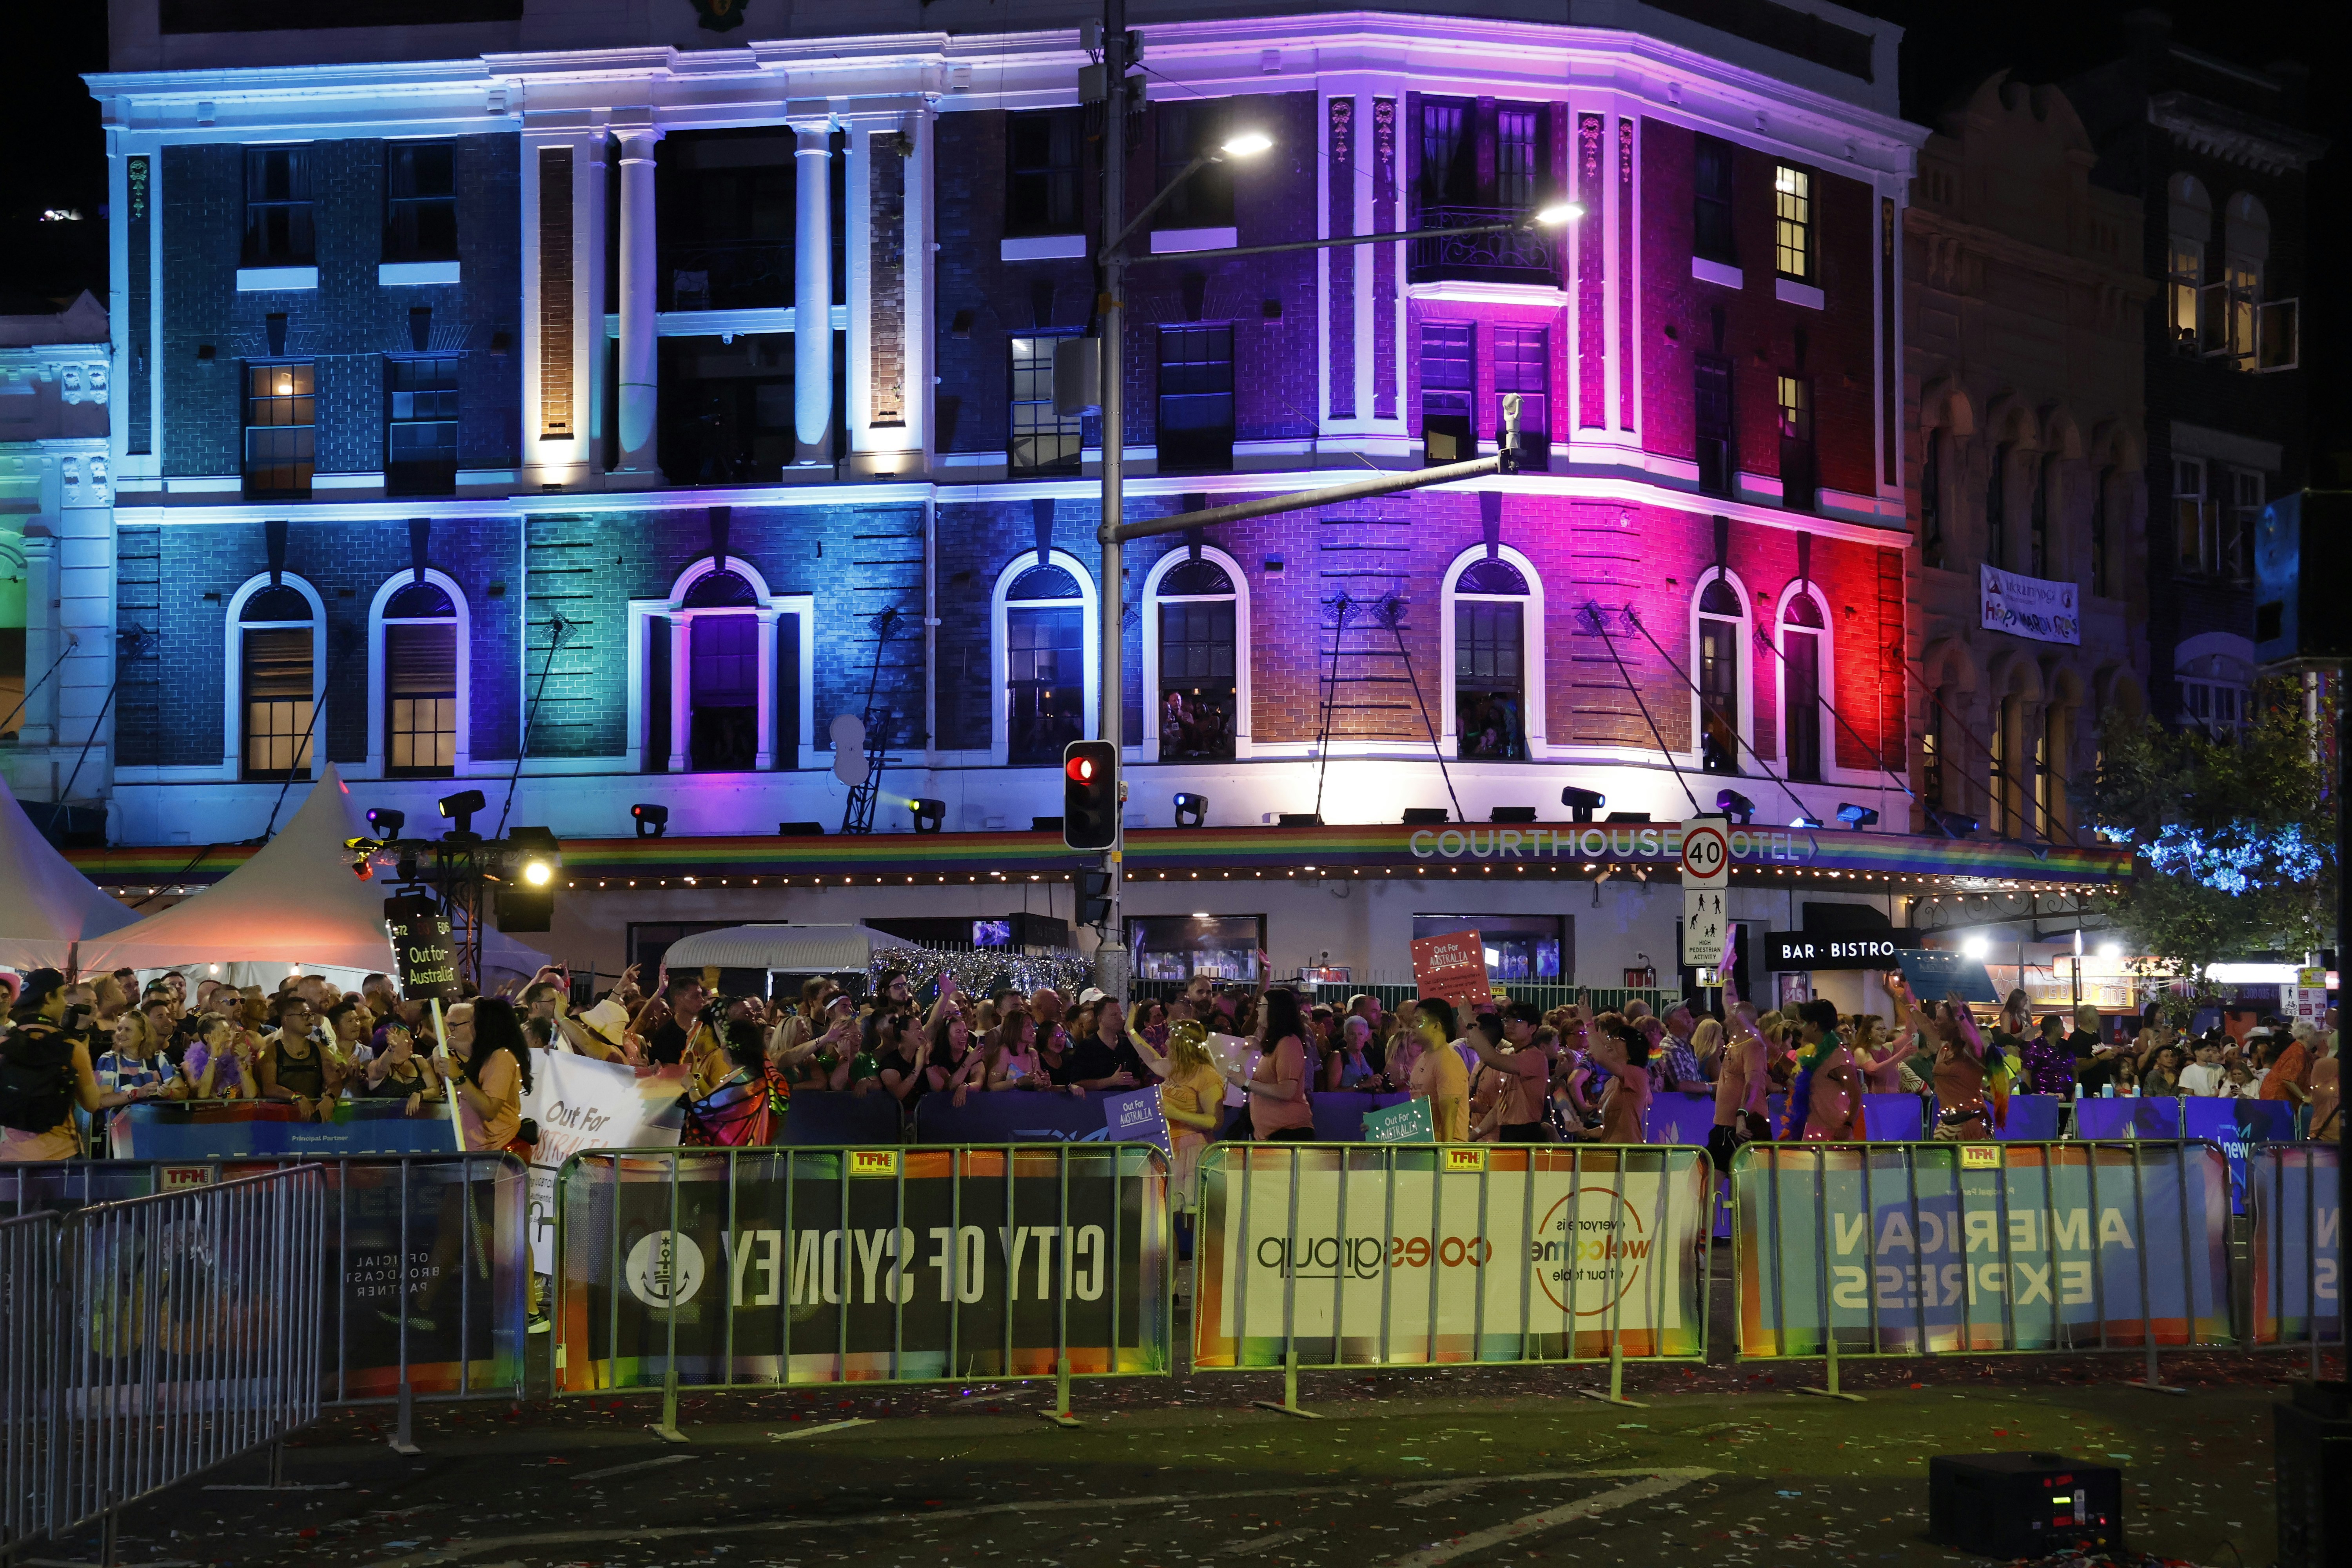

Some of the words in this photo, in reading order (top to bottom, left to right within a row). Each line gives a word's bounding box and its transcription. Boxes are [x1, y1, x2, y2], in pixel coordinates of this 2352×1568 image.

[1409, 828, 1681, 858] COURTHOUSE
[1729, 830, 1800, 860] OTEL
[1689, 842, 1720, 863] 40
[409, 947, 431, 964] Out
[430, 945, 445, 961] for
[1433, 945, 1446, 954] Out
[1782, 944, 1815, 959] BAR
[1831, 941, 1894, 957] BISTRO
[1430, 951, 1468, 966] AUSTRALIA
[410, 965, 454, 985] Australia
[2036, 976, 2092, 1000] KEBB
[2099, 988, 2126, 1005] PIDE
[1123, 1102, 1133, 1112] Out
[1134, 1100, 1144, 1108] For
[546, 1100, 581, 1128] Out
[579, 1107, 611, 1132] For
[1120, 1107, 1153, 1125] AUSTRALIA
[1385, 1116, 1397, 1126] Out
[1398, 1113, 1409, 1123] For
[1380, 1120, 1418, 1141] AUSTRALIA
[857, 1153, 889, 1165] TFH
[1451, 1151, 1477, 1163] TFH
[1966, 1149, 1992, 1159] TFH
[167, 1169, 205, 1183] TFH
